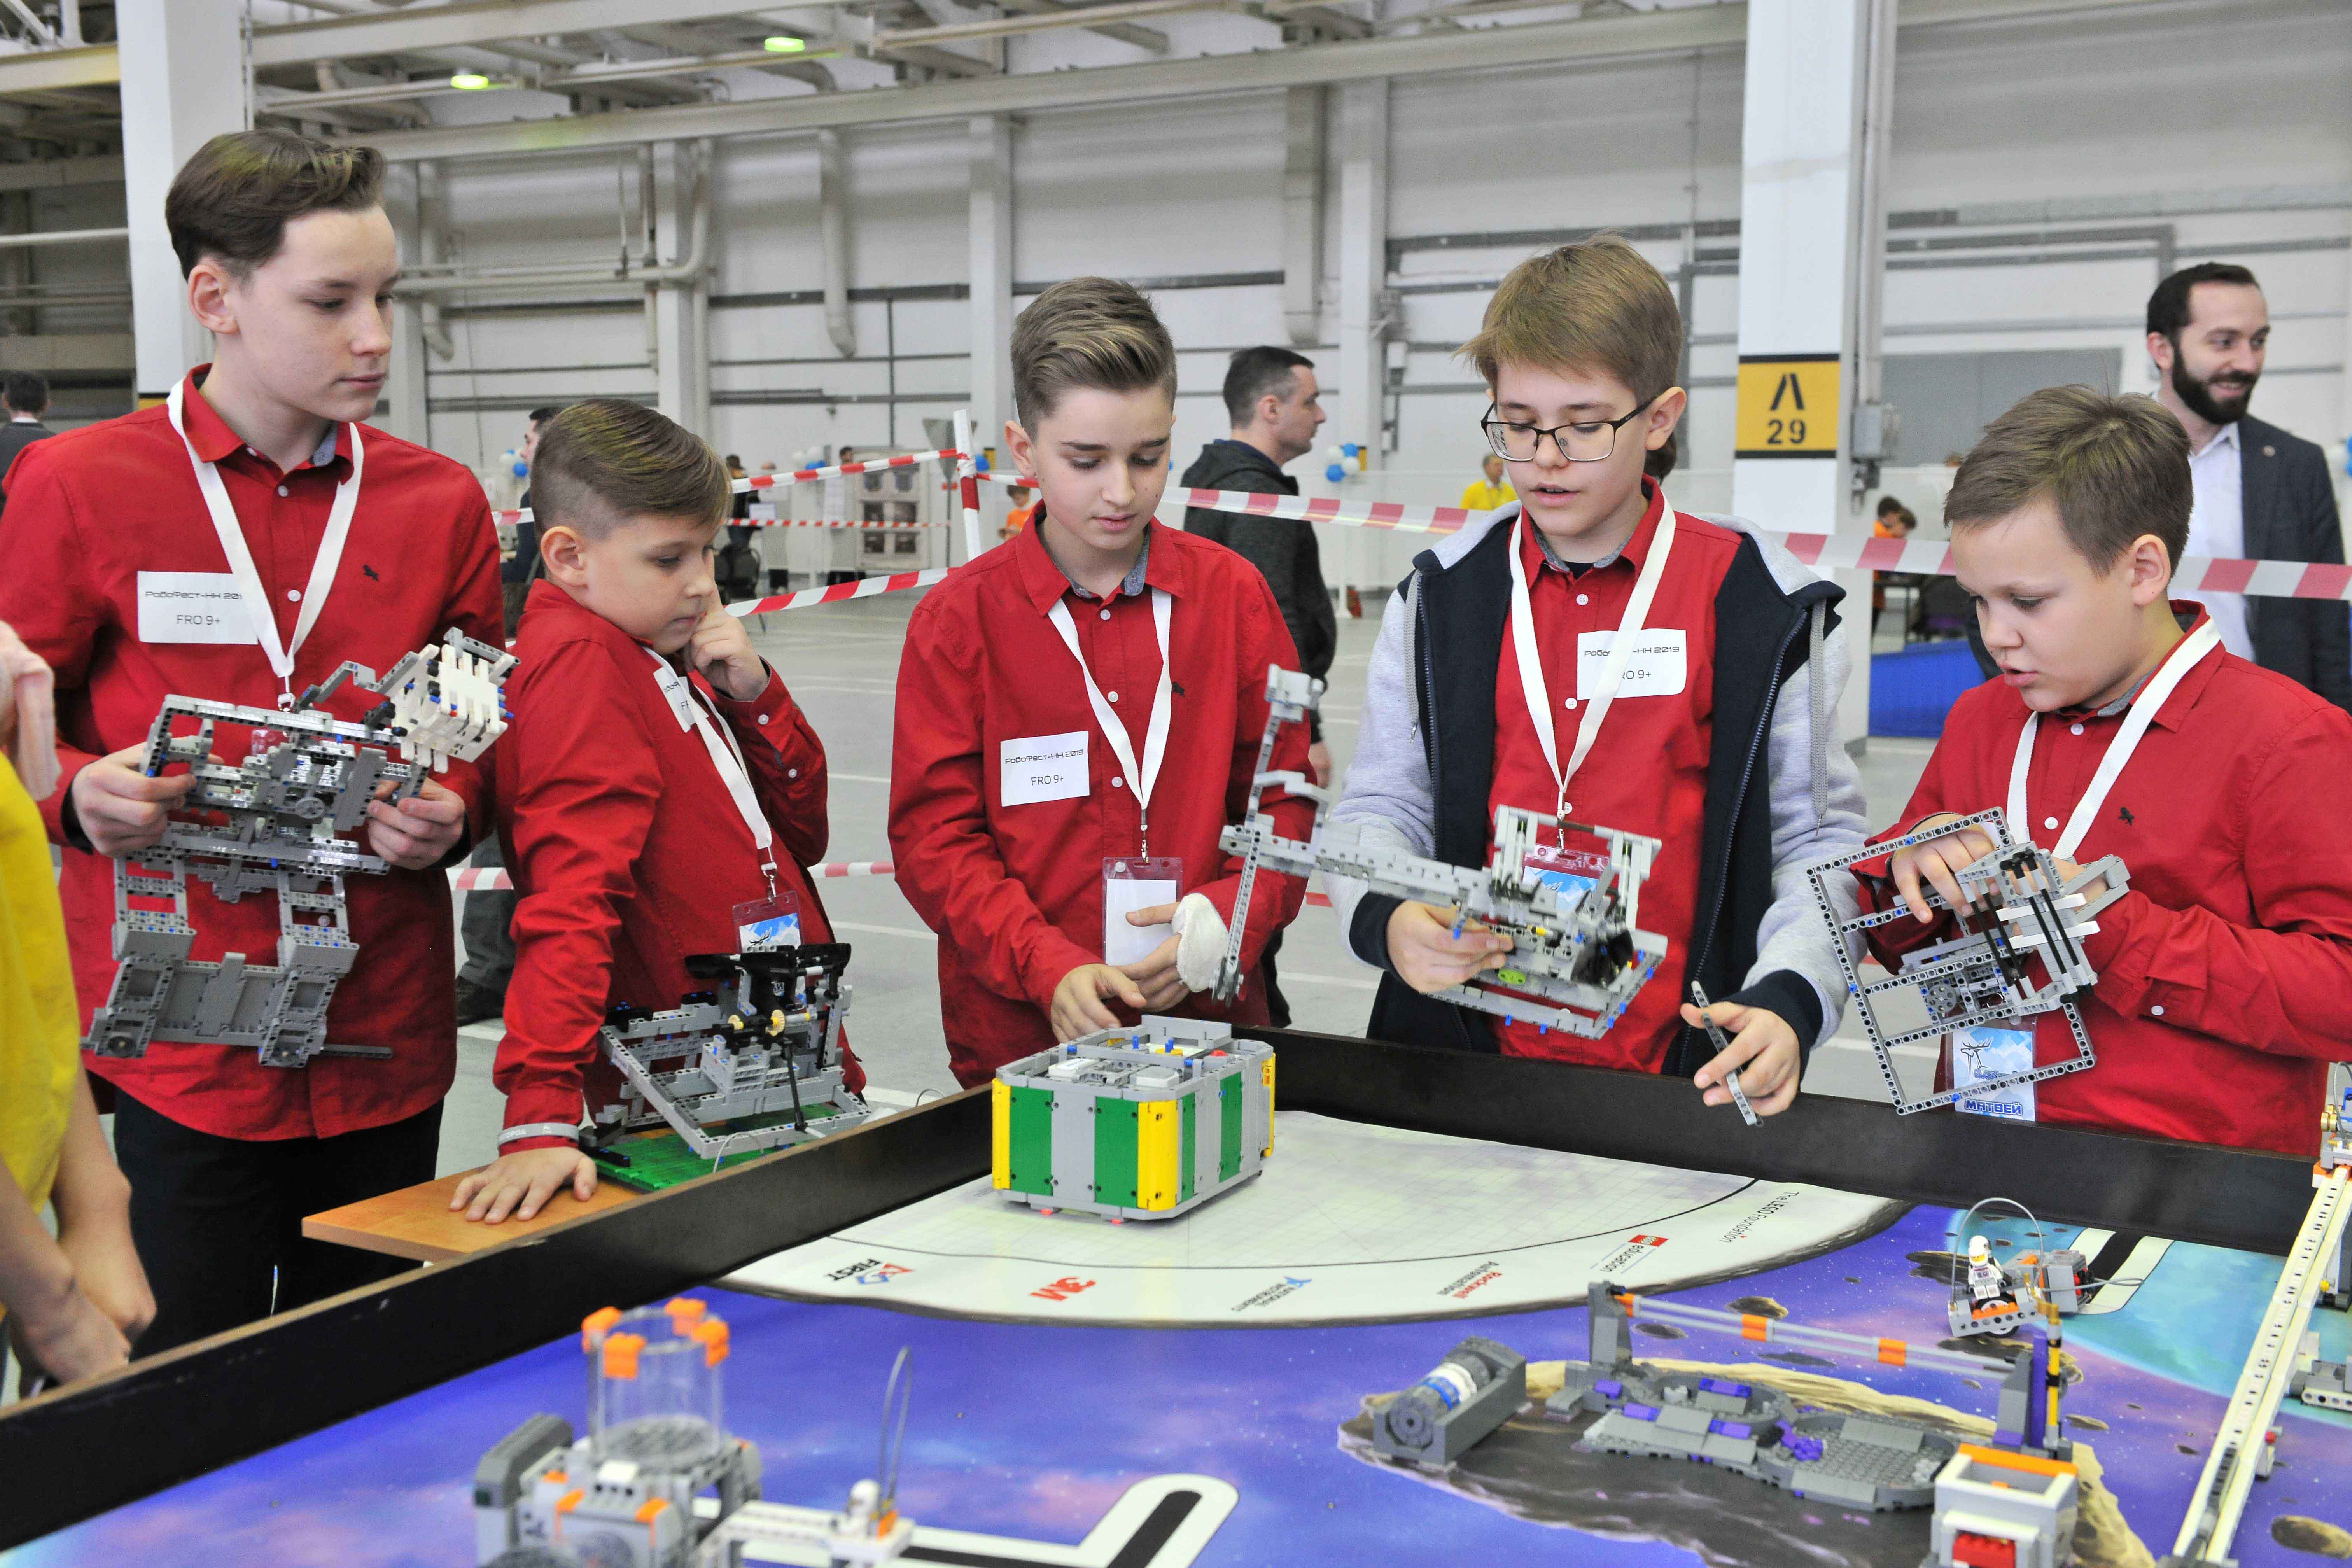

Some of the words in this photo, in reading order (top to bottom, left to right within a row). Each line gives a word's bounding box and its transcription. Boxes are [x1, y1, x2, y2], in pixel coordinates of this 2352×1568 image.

[1768, 419, 1806, 444] 29
[177, 615, 203, 625] FRO
[206, 615, 220, 625] 9+
[1638, 670, 1651, 679] 9+
[1065, 749, 1083, 758] 2019
[1031, 775, 1051, 786] FRO
[1054, 774, 1064, 784] 9+
[1776, 1192, 1800, 1200] The
[1757, 1200, 1789, 1214] LEGO
[1719, 1214, 1767, 1243] Foundation
[1029, 1276, 1097, 1302] 3M
